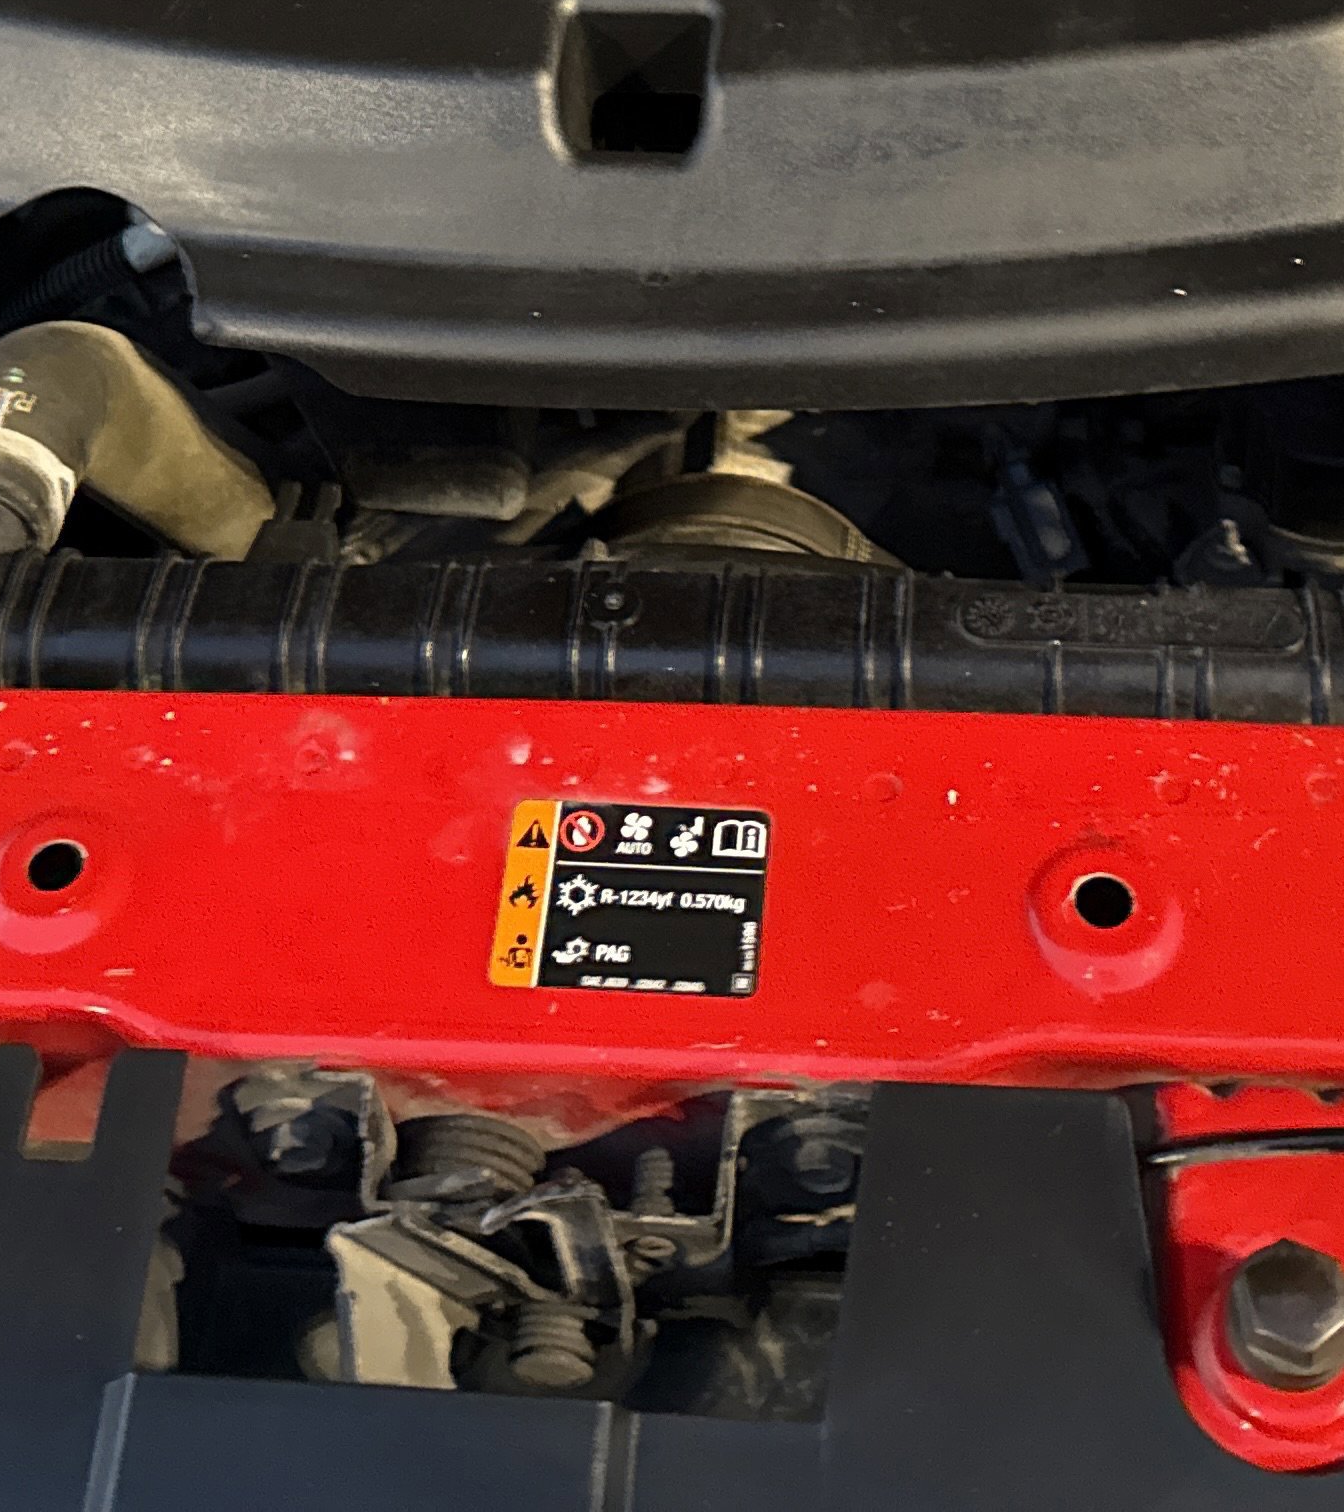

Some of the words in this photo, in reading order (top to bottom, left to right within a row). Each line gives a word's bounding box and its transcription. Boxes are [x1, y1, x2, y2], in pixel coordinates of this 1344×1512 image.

[614, 841, 654, 856] AUTO
[600, 890, 675, 910] R-1234yf
[679, 892, 747, 915] 0.570kg
[594, 943, 633, 964] PAG
